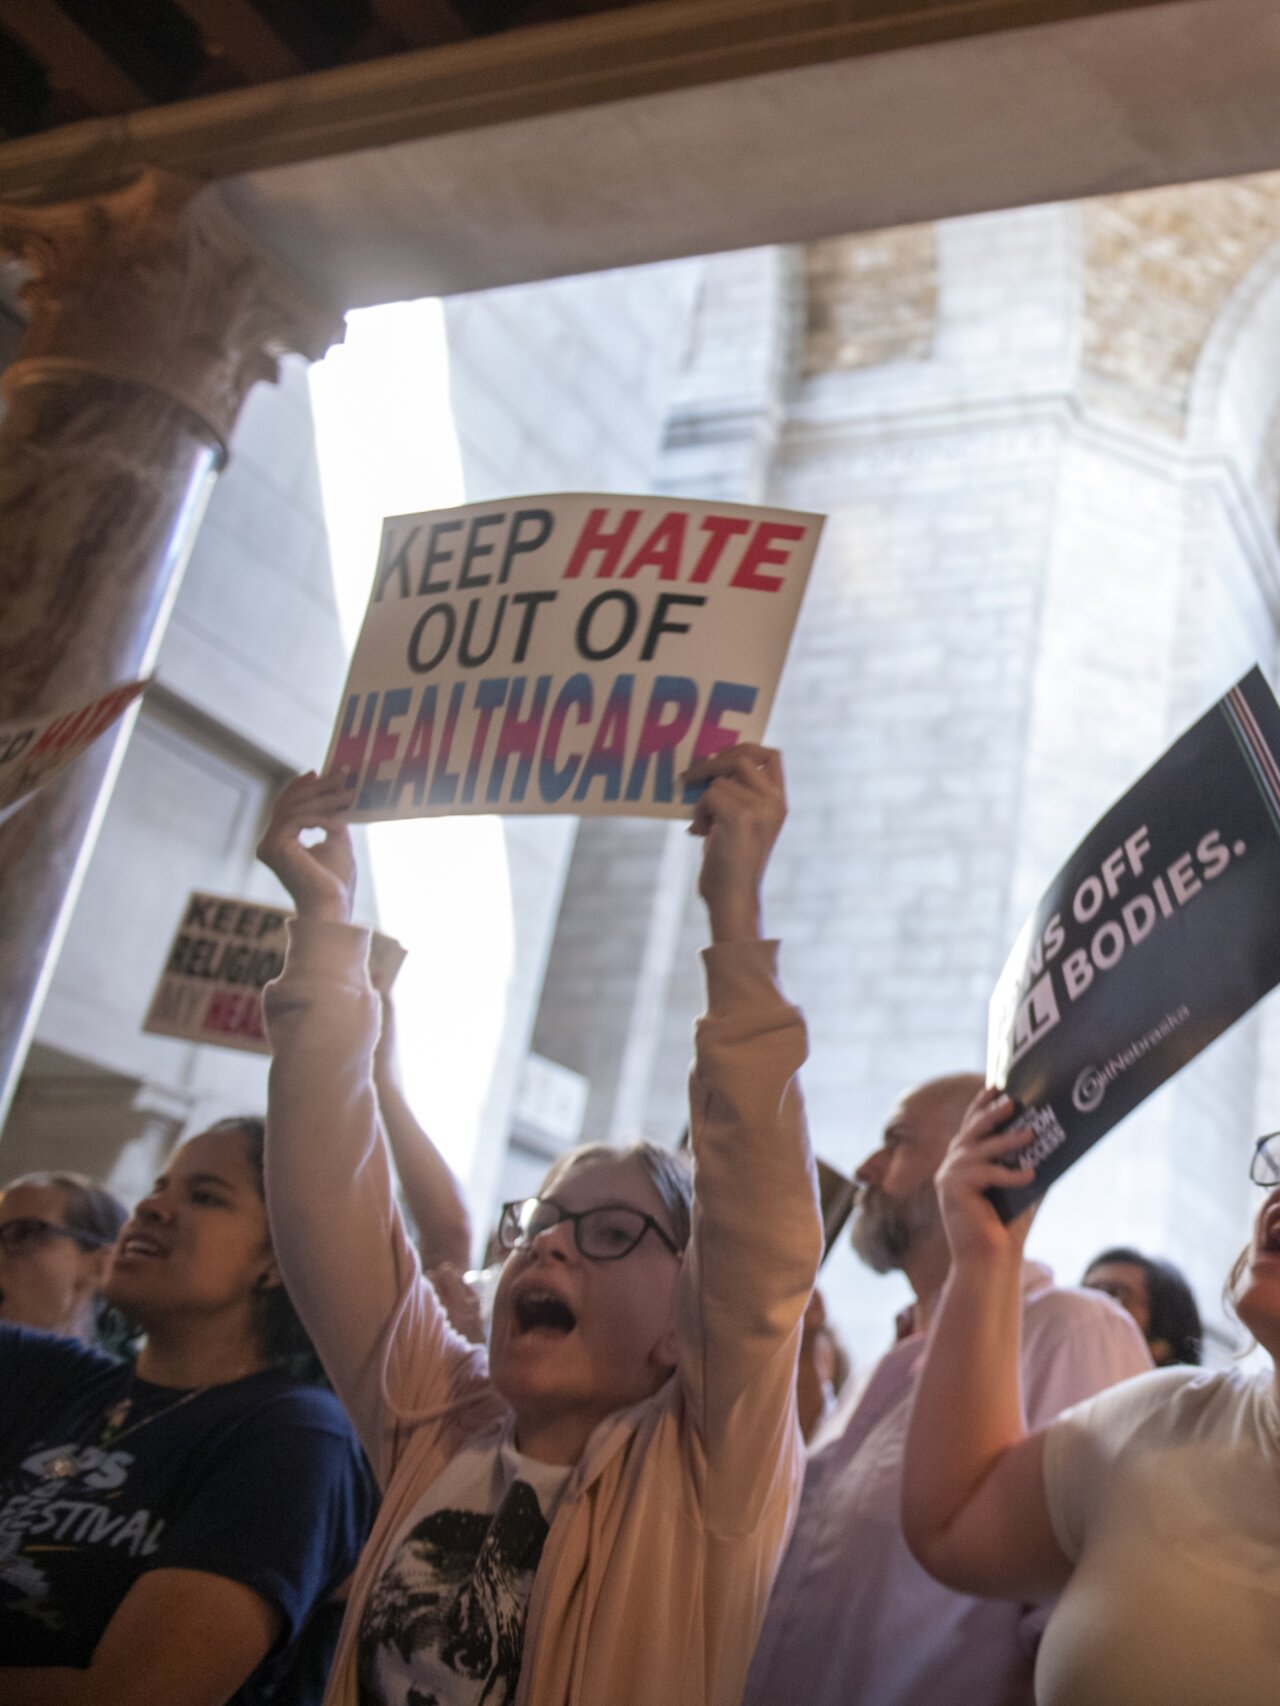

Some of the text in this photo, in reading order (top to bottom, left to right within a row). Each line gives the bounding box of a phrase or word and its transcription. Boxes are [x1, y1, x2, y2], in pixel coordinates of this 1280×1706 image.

[374, 508, 807, 602] KEEP HATE
[407, 589, 707, 673] OUT OF
[330, 673, 760, 810] HEALTHCARE
[184, 898, 288, 938] KEEP
[1061, 829, 1247, 1001] BODIES.
[1072, 824, 1151, 924] OFF
